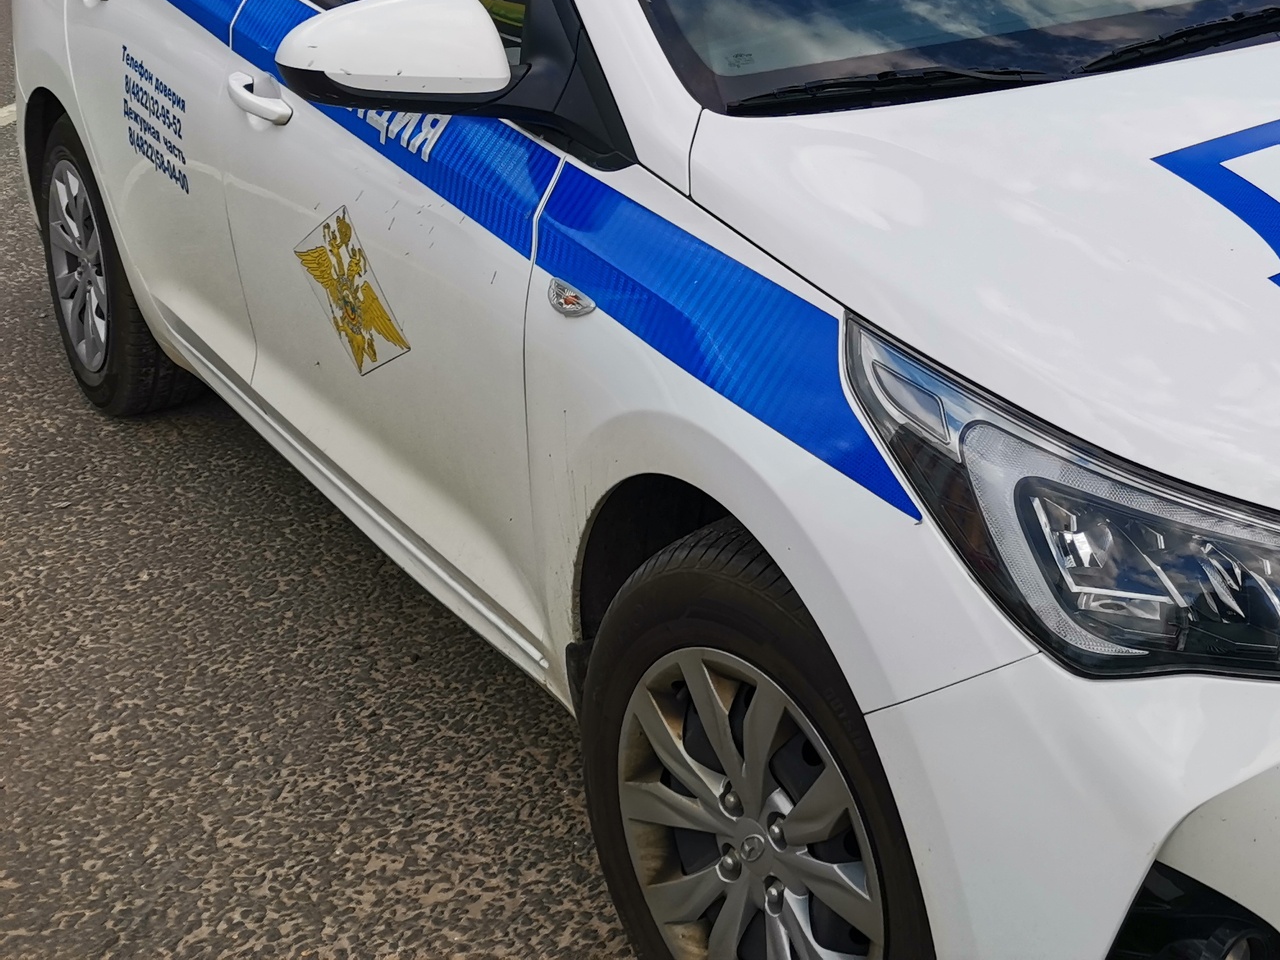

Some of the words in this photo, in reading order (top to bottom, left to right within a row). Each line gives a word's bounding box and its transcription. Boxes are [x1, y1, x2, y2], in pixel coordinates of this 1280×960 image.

[122, 44, 154, 86] Телефон
[154, 77, 186, 113] доверия
[123, 98, 161, 144] Дежурная
[162, 135, 186, 165] часть
